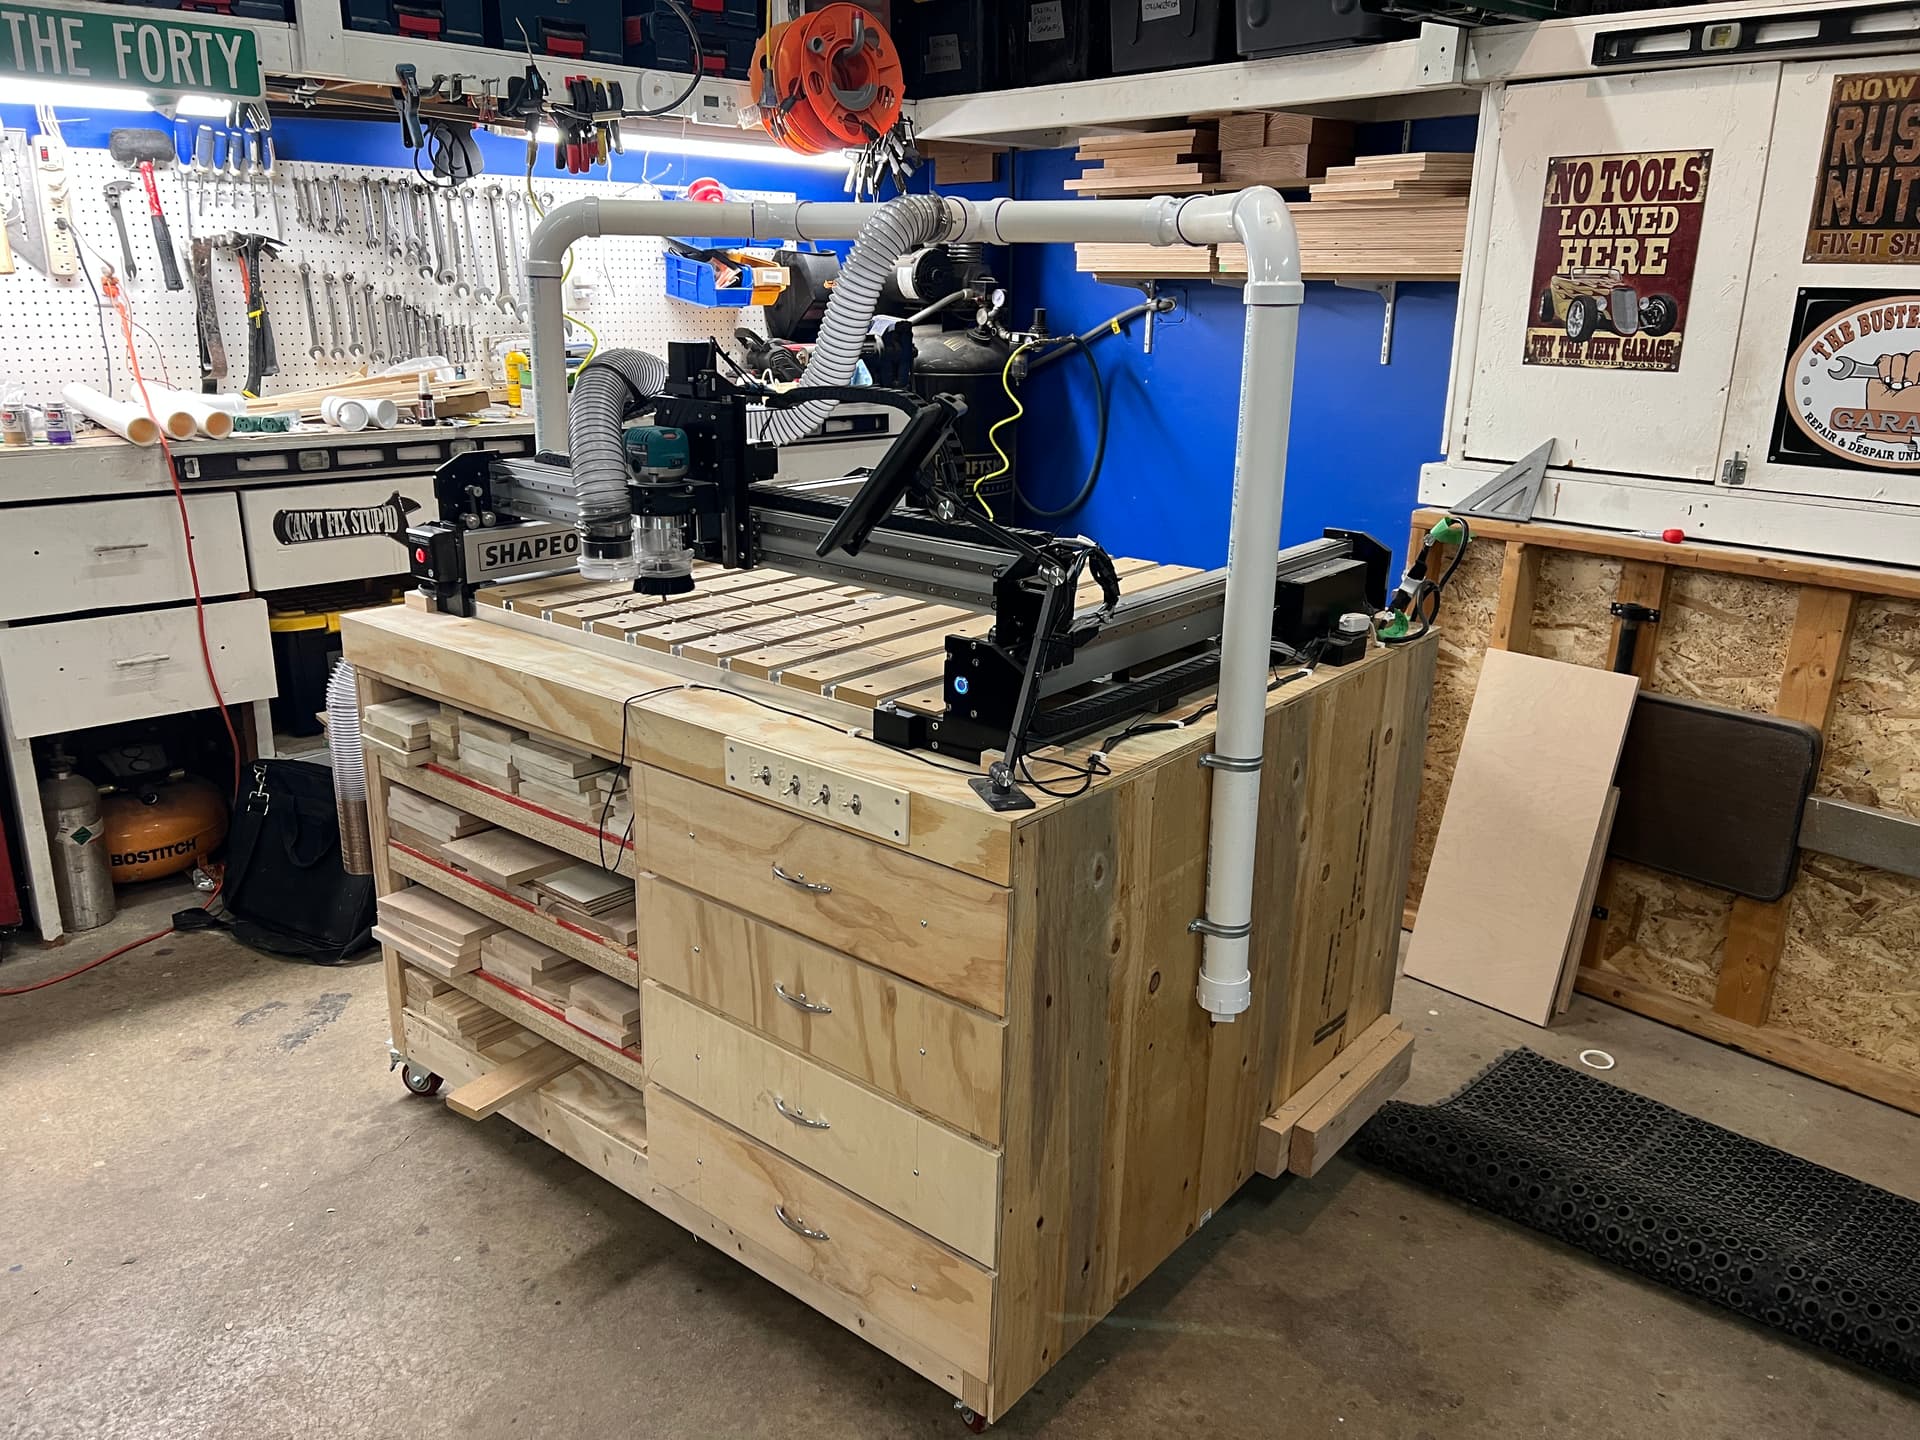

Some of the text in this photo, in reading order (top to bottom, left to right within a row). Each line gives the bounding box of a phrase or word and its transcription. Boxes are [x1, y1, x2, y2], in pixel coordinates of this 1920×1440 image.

[1, 11, 242, 89] THE FORTY
[1841, 76, 1916, 101] NOW
[1550, 157, 1701, 204] NO TOOLS
[1821, 166, 1920, 226] NUT
[1558, 206, 1680, 236] LOANED
[1556, 237, 1671, 276] HERE
[1817, 232, 1884, 256] FIX-IT
[1531, 335, 1675, 363] TRY THE NEXT GARAGE
[1812, 304, 1920, 361] THE BUSTE
[1565, 358, 1586, 366] YOU
[1588, 359, 1665, 369] UNDERSTAND
[1804, 411, 1920, 461] REPAIR & DESPAIR UND
[1833, 411, 1920, 434] GARA
[284, 504, 399, 541] CAN'T FIX STUPID
[485, 533, 579, 567] SHAPEO
[110, 837, 197, 867] BOSTITCH
